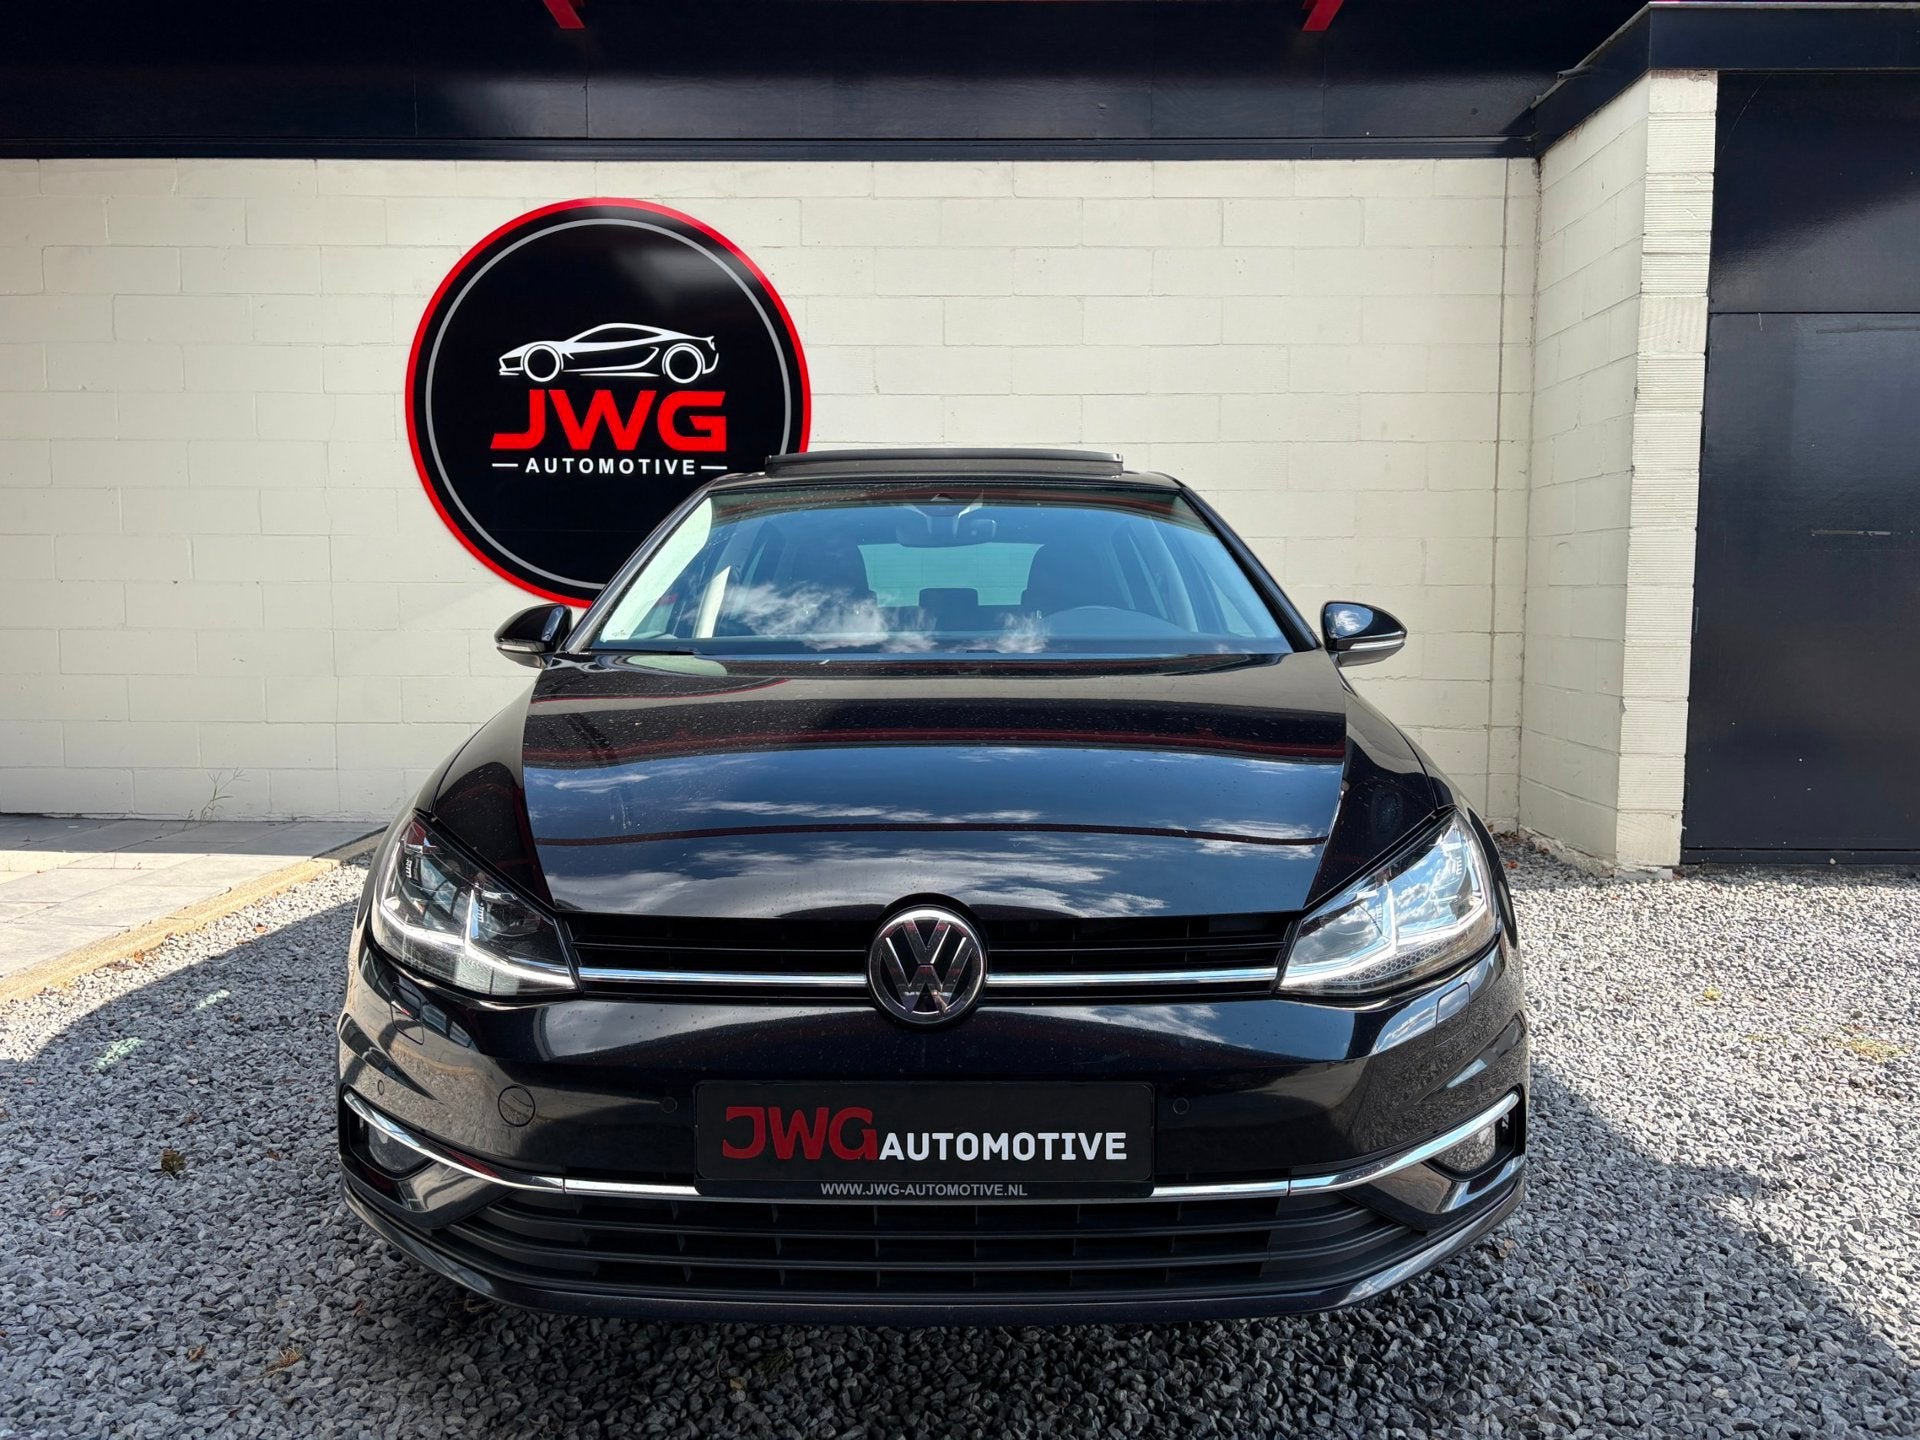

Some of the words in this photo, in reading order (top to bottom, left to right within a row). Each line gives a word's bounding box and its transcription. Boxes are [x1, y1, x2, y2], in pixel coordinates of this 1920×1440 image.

[490, 389, 727, 452] JWG
[525, 457, 695, 475] AUTOMOTIVE
[722, 1106, 878, 1160] JWG
[879, 1132, 1128, 1161] AUTOMOTIVE
[820, 1182, 1028, 1198] WWW.JWG-AUTOMOTIVE.NL
